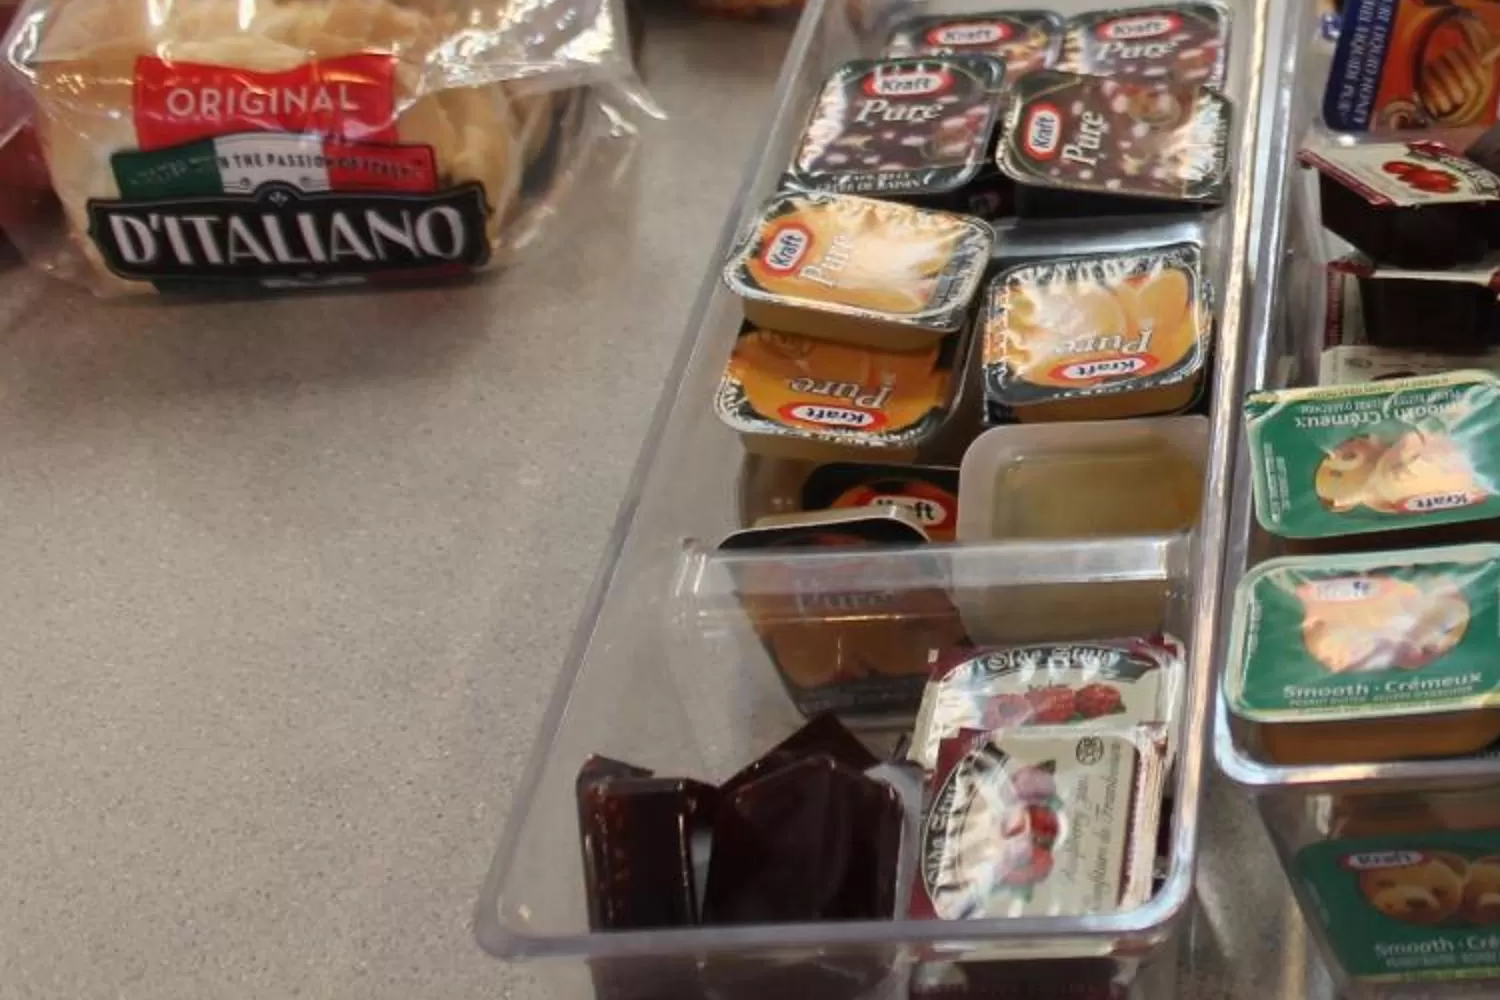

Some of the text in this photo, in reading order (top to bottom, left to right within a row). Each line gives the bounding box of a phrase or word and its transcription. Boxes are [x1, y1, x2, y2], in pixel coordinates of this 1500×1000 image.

[941, 23, 995, 44] Kraft
[1113, 20, 1168, 38] Kraft
[880, 72, 932, 94] Kraft
[166, 85, 360, 118] ORIGINAL
[855, 98, 943, 123] Pure
[1034, 113, 1056, 150] Kraft
[1061, 110, 1105, 166] Pure
[233, 152, 263, 169] THE
[108, 206, 466, 267] D'ITALIANO
[770, 234, 803, 267] Kraft
[800, 234, 854, 288] Pure
[1076, 359, 1136, 377] Kraft
[790, 372, 897, 409] Pure
[806, 407, 866, 425] Kraft
[1294, 408, 1382, 429] Crémeux
[1282, 681, 1370, 699] Smooth
[1384, 671, 1482, 693] Crémeux
[1374, 936, 1455, 957] Smooth
